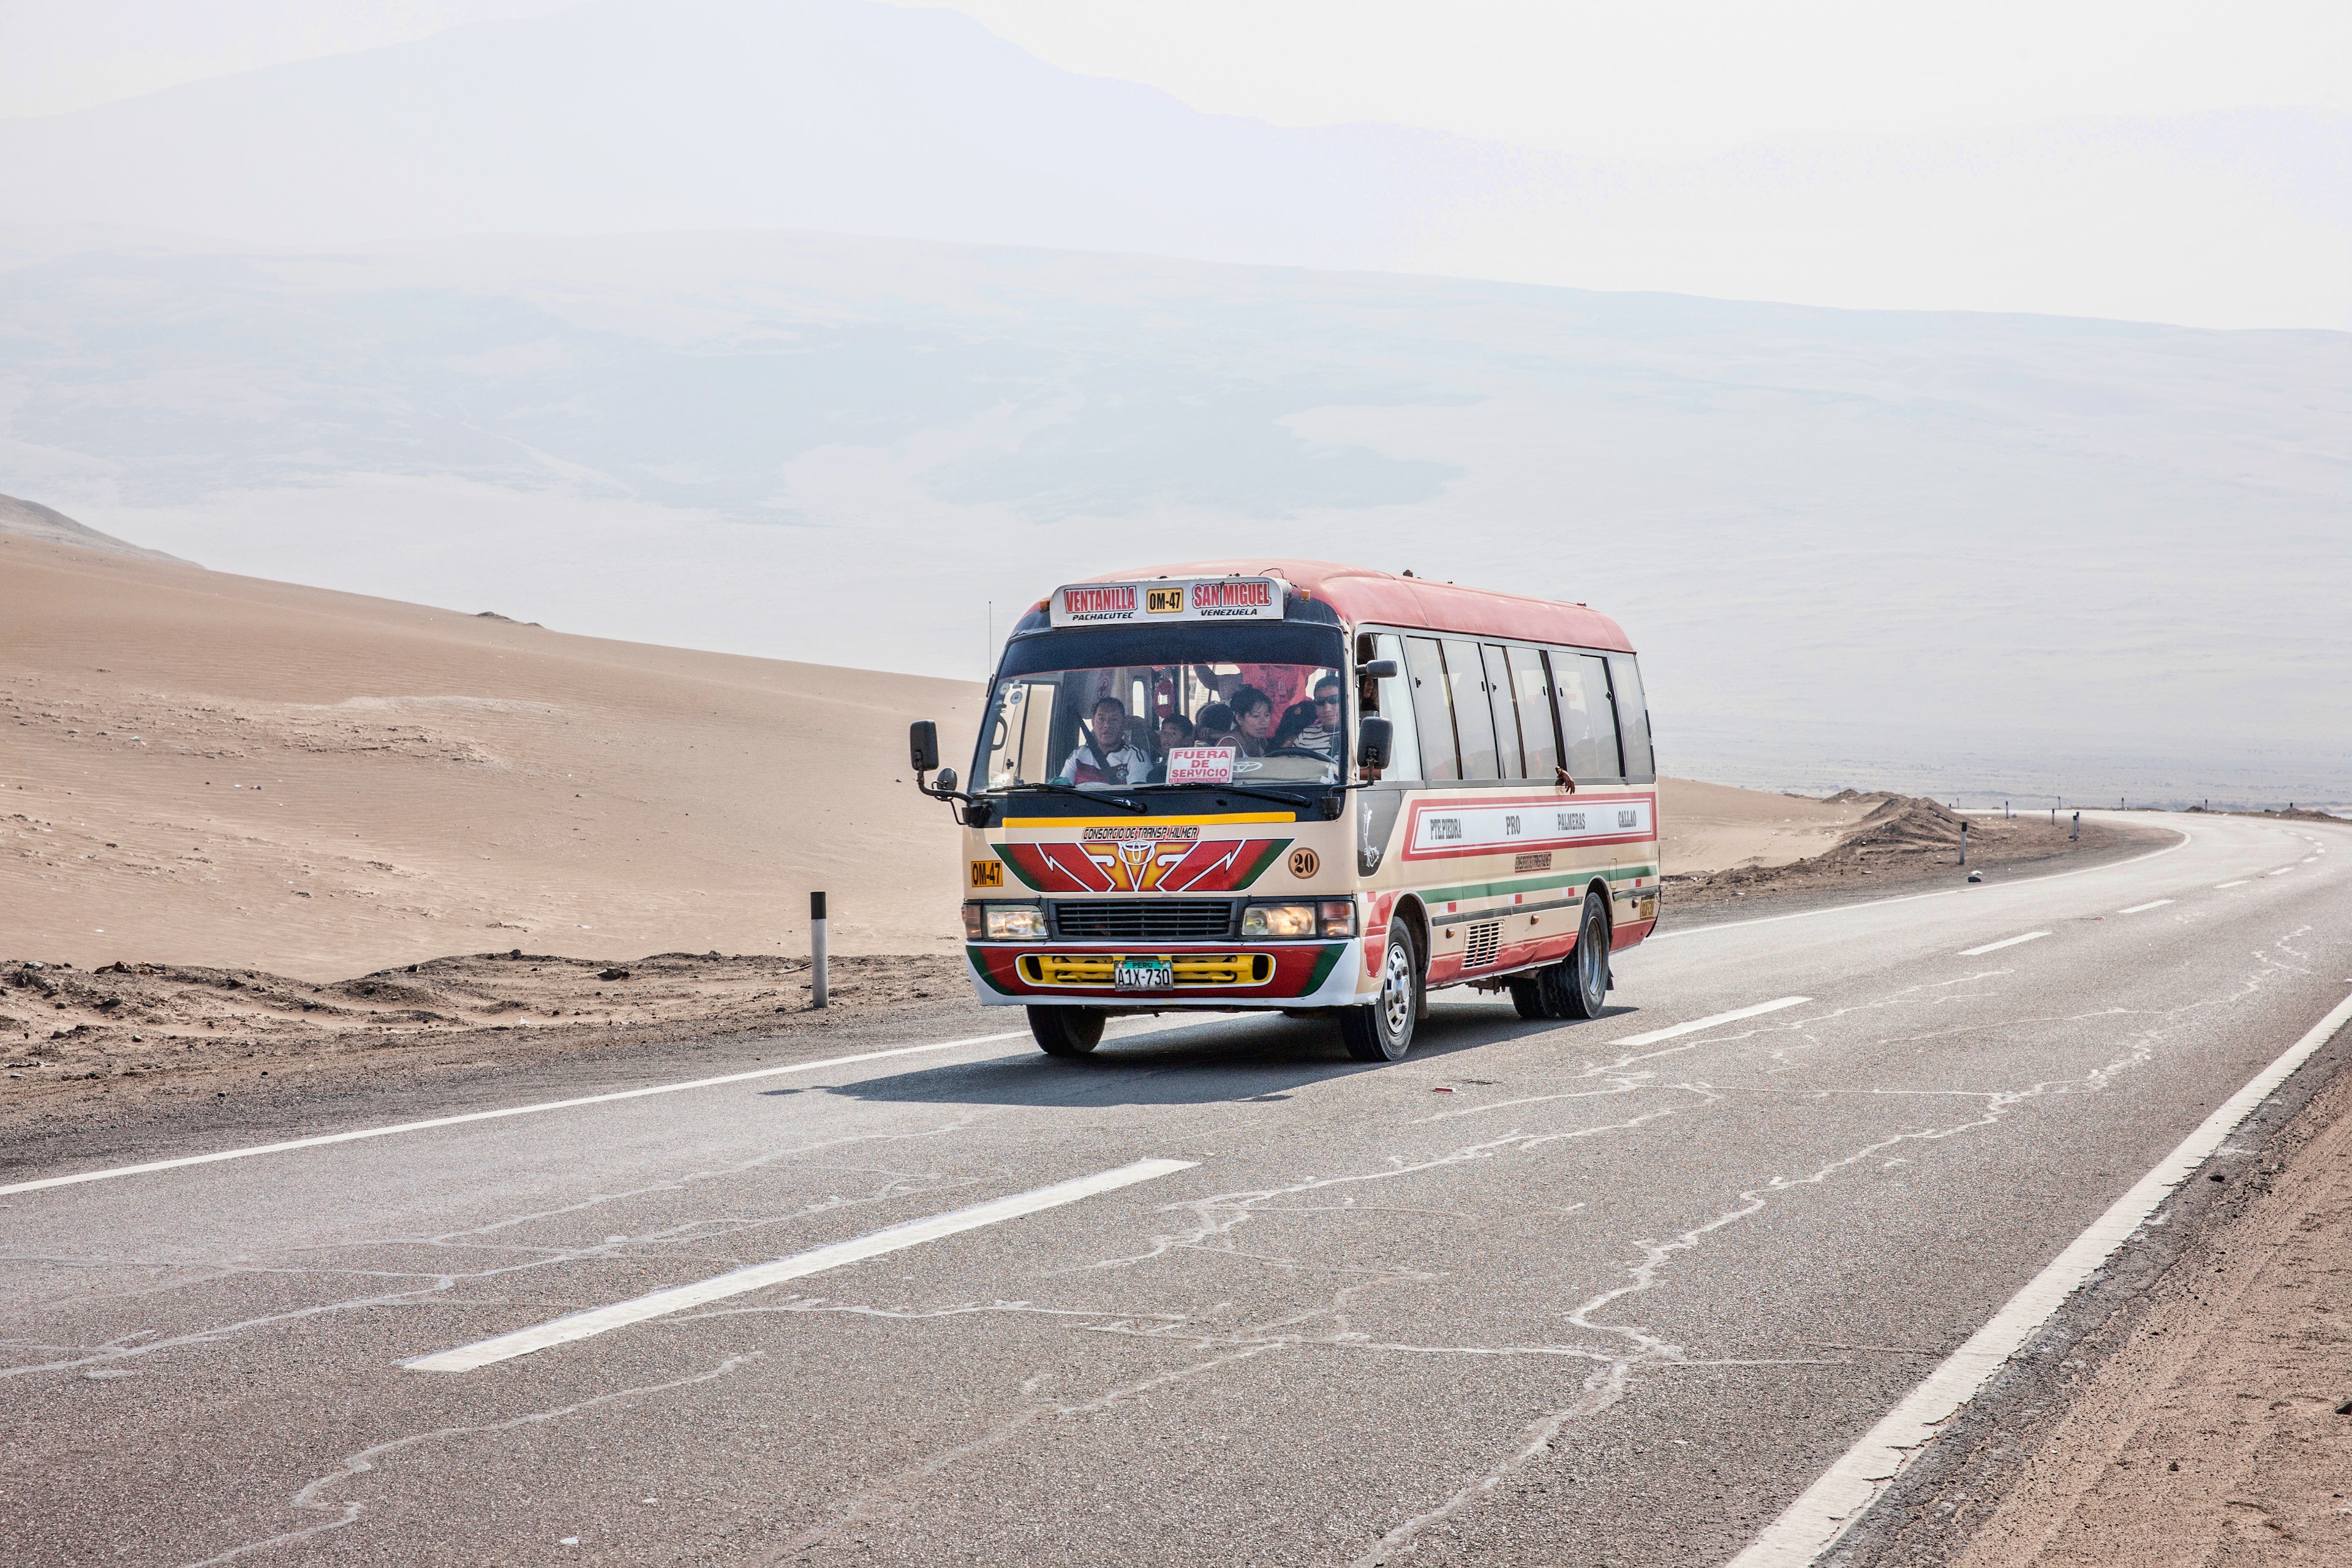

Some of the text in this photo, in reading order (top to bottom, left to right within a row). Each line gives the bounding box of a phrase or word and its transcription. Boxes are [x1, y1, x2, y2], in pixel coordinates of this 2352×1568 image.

[1064, 586, 1137, 613] VENTANILLA
[1149, 592, 1181, 610] OM-47
[1193, 582, 1271, 608] SAN MIGUEL
[1174, 750, 1229, 759] FUERA
[1172, 769, 1228, 777] SERVICIO
[1506, 815, 1521, 835] PRO
[1558, 813, 1586, 831] PALMERAS
[1618, 810, 1637, 828] CALLAO
[1084, 827, 1198, 840] CONSORCIO DE TRANSP. KILMER
[1294, 853, 1314, 873] 20
[973, 862, 1000, 886] OM-47
[1118, 968, 1170, 986] A1X-730
